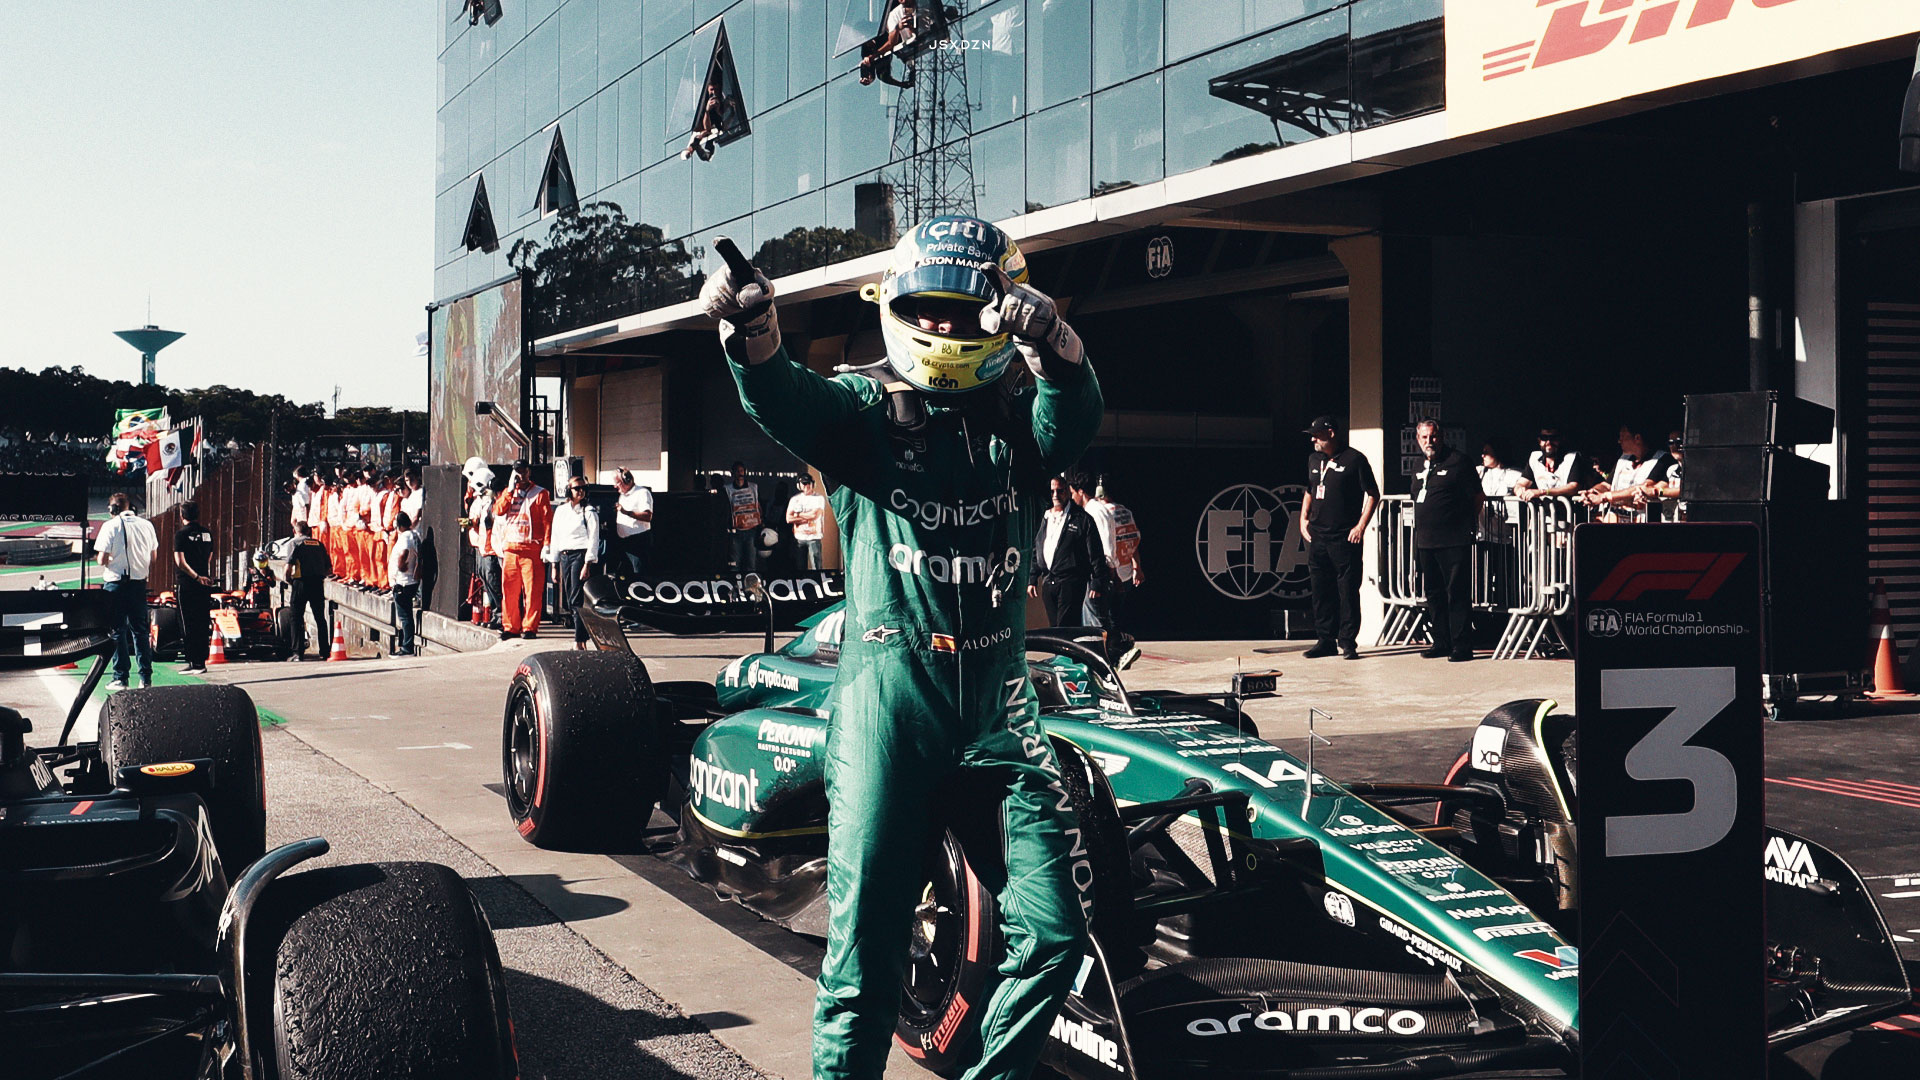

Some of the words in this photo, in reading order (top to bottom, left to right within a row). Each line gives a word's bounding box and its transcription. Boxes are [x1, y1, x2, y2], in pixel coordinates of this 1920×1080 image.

[926, 241, 965, 253] Private
[967, 244, 993, 261] Bank
[917, 256, 954, 267] ASTON
[931, 361, 970, 369] crypto.com
[627, 572, 840, 605] cogniant
[1625, 612, 1645, 623] FIA
[1646, 611, 1695, 623] Formula
[1697, 611, 1704, 622] 1
[1625, 624, 1660, 636] World
[1662, 623, 1743, 637] Championship
[962, 627, 1011, 650] ALONSO
[758, 669, 799, 692] crypto.com
[758, 719, 817, 748] PERONI
[1600, 666, 1738, 858] 3
[1221, 760, 1323, 789] 14
[1324, 824, 1406, 837] NexGen
[1349, 838, 1424, 851] VELOCITY
[1375, 846, 1418, 855] BLACK
[1376, 856, 1460, 872] PERONI
[1426, 889, 1505, 902] SentinelOne
[1445, 904, 1531, 920] NetApp
[1379, 916, 1463, 973] GIRARD-PERREGAUX
[1186, 1007, 1426, 1036] aramco
